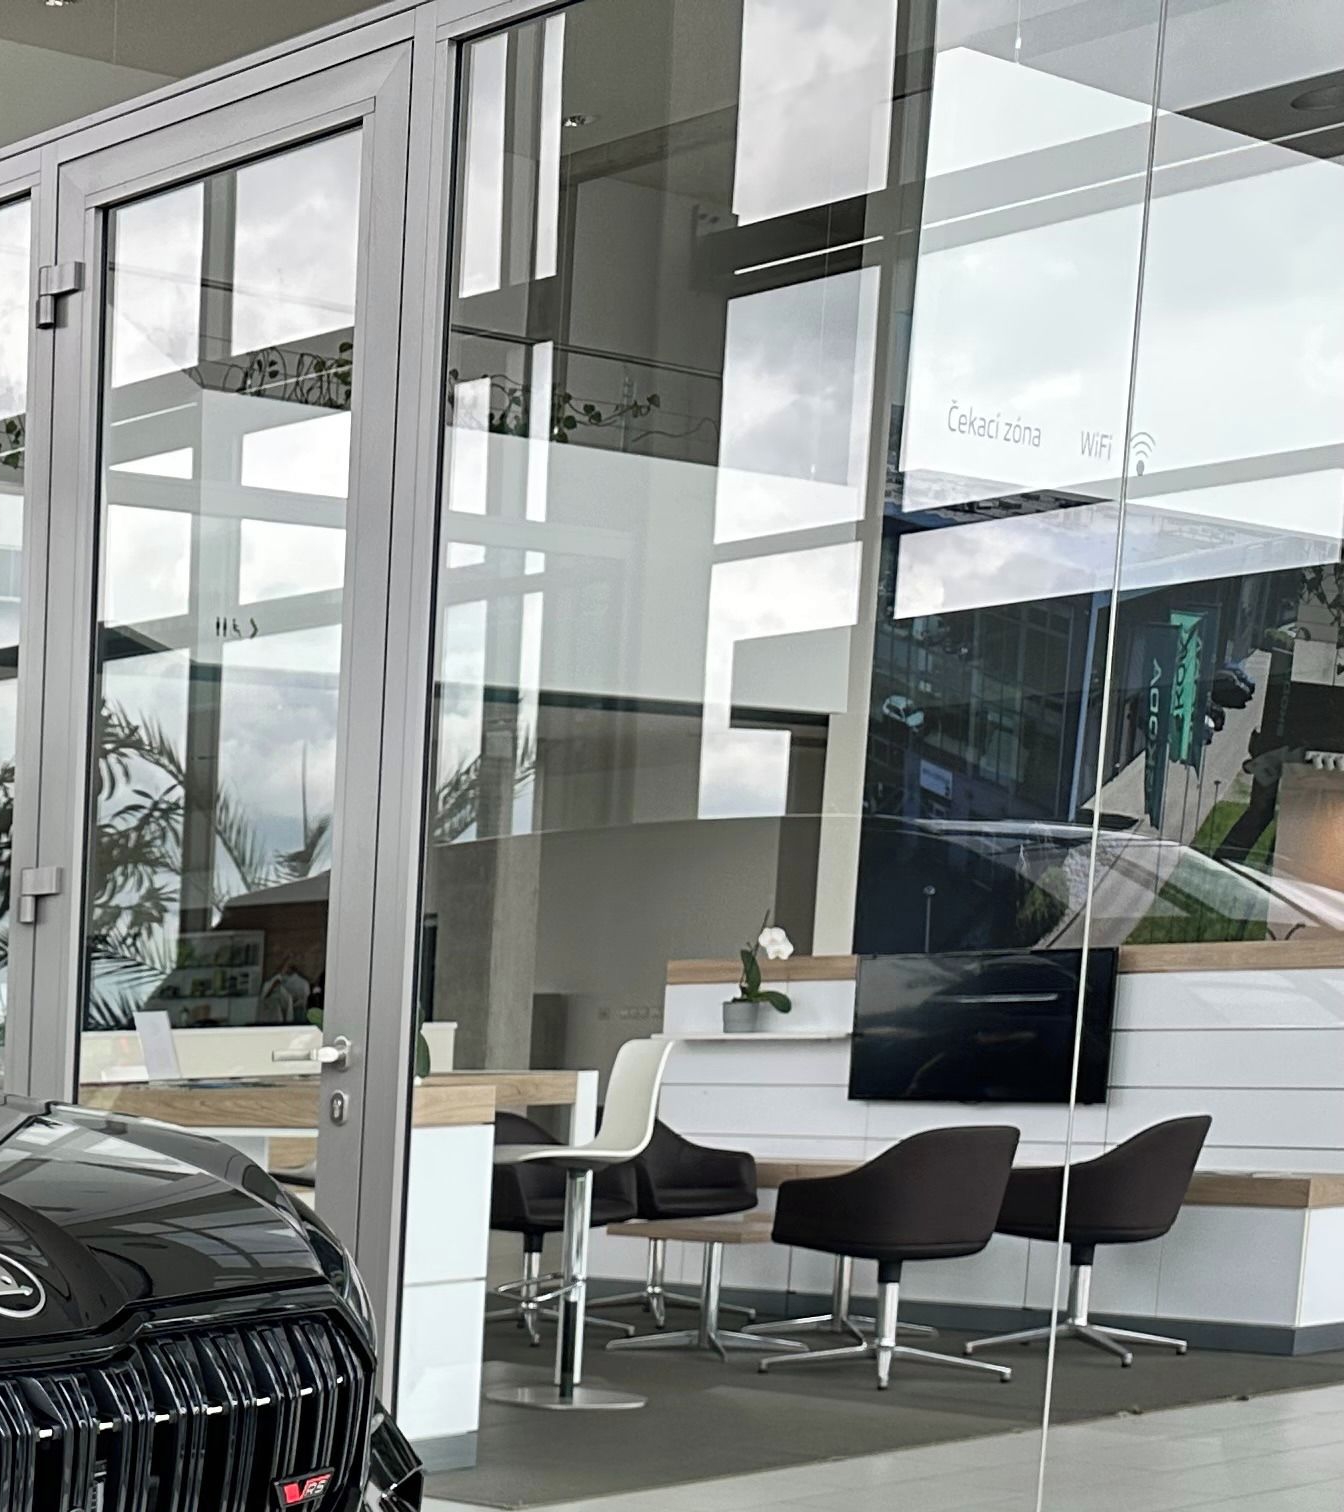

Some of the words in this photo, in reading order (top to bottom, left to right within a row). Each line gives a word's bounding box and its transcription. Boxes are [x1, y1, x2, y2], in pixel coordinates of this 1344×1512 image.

[947, 399, 1001, 440] Čekací
[1003, 415, 1042, 448] zóna
[1080, 430, 1113, 461] WiFi
